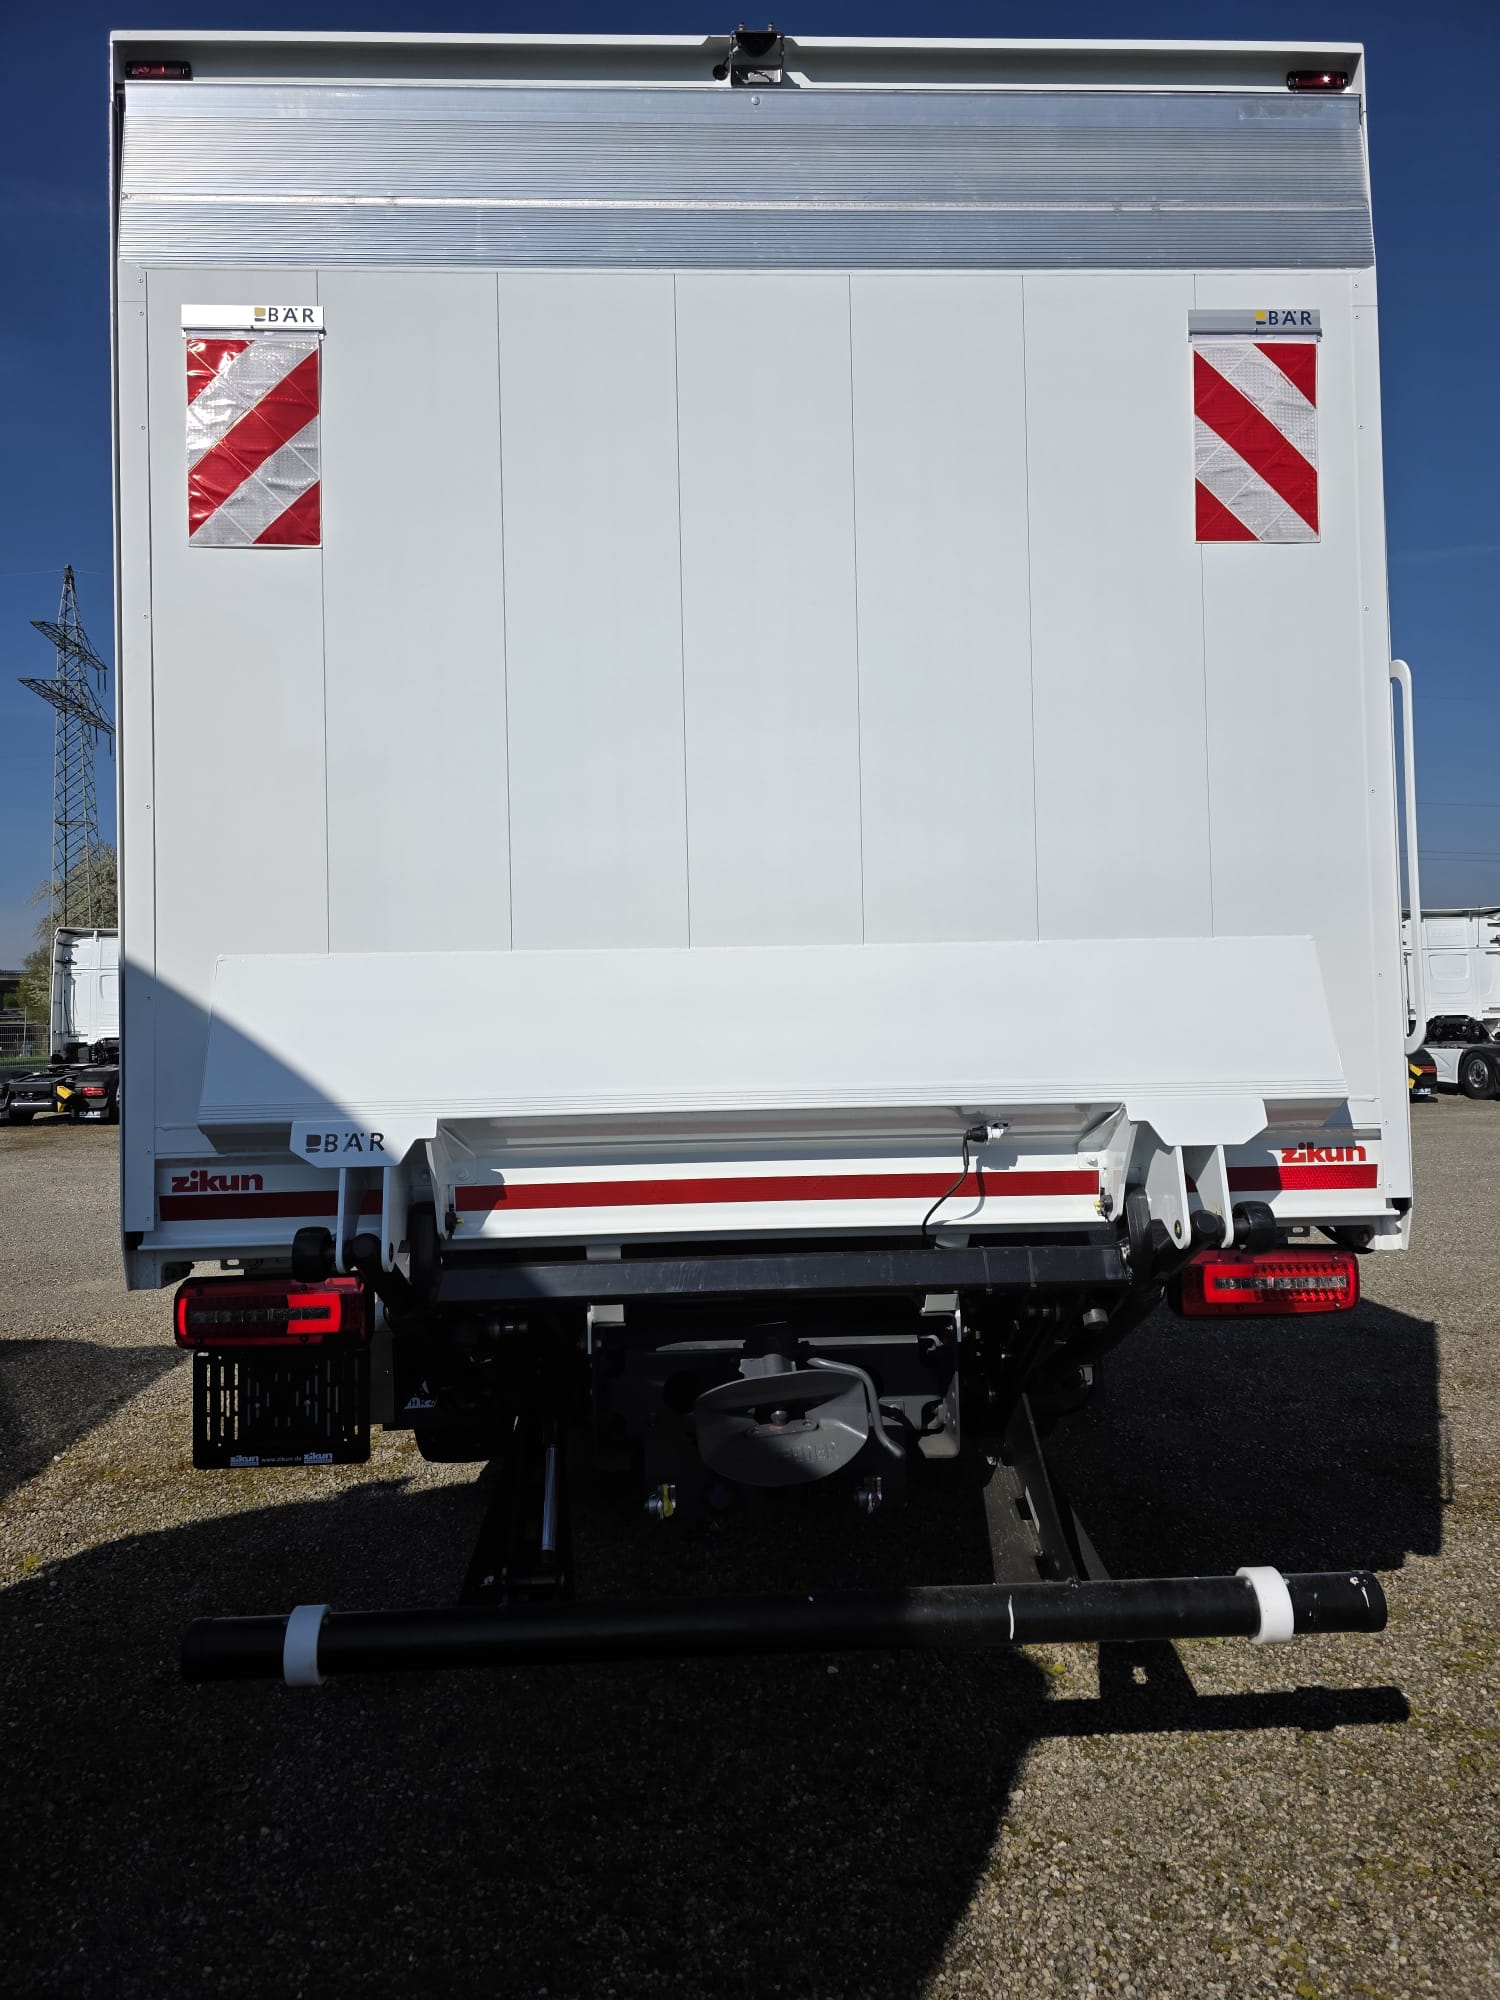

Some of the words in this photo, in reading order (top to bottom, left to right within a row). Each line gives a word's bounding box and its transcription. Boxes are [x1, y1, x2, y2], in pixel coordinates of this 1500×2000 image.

[268, 307, 314, 323] BÄR
[1268, 310, 1312, 326] BÄR
[324, 1132, 385, 1153] BÄR
[1281, 1142, 1366, 1163] zikun
[171, 1170, 263, 1193] zikun
[303, 1452, 333, 1460] zikun
